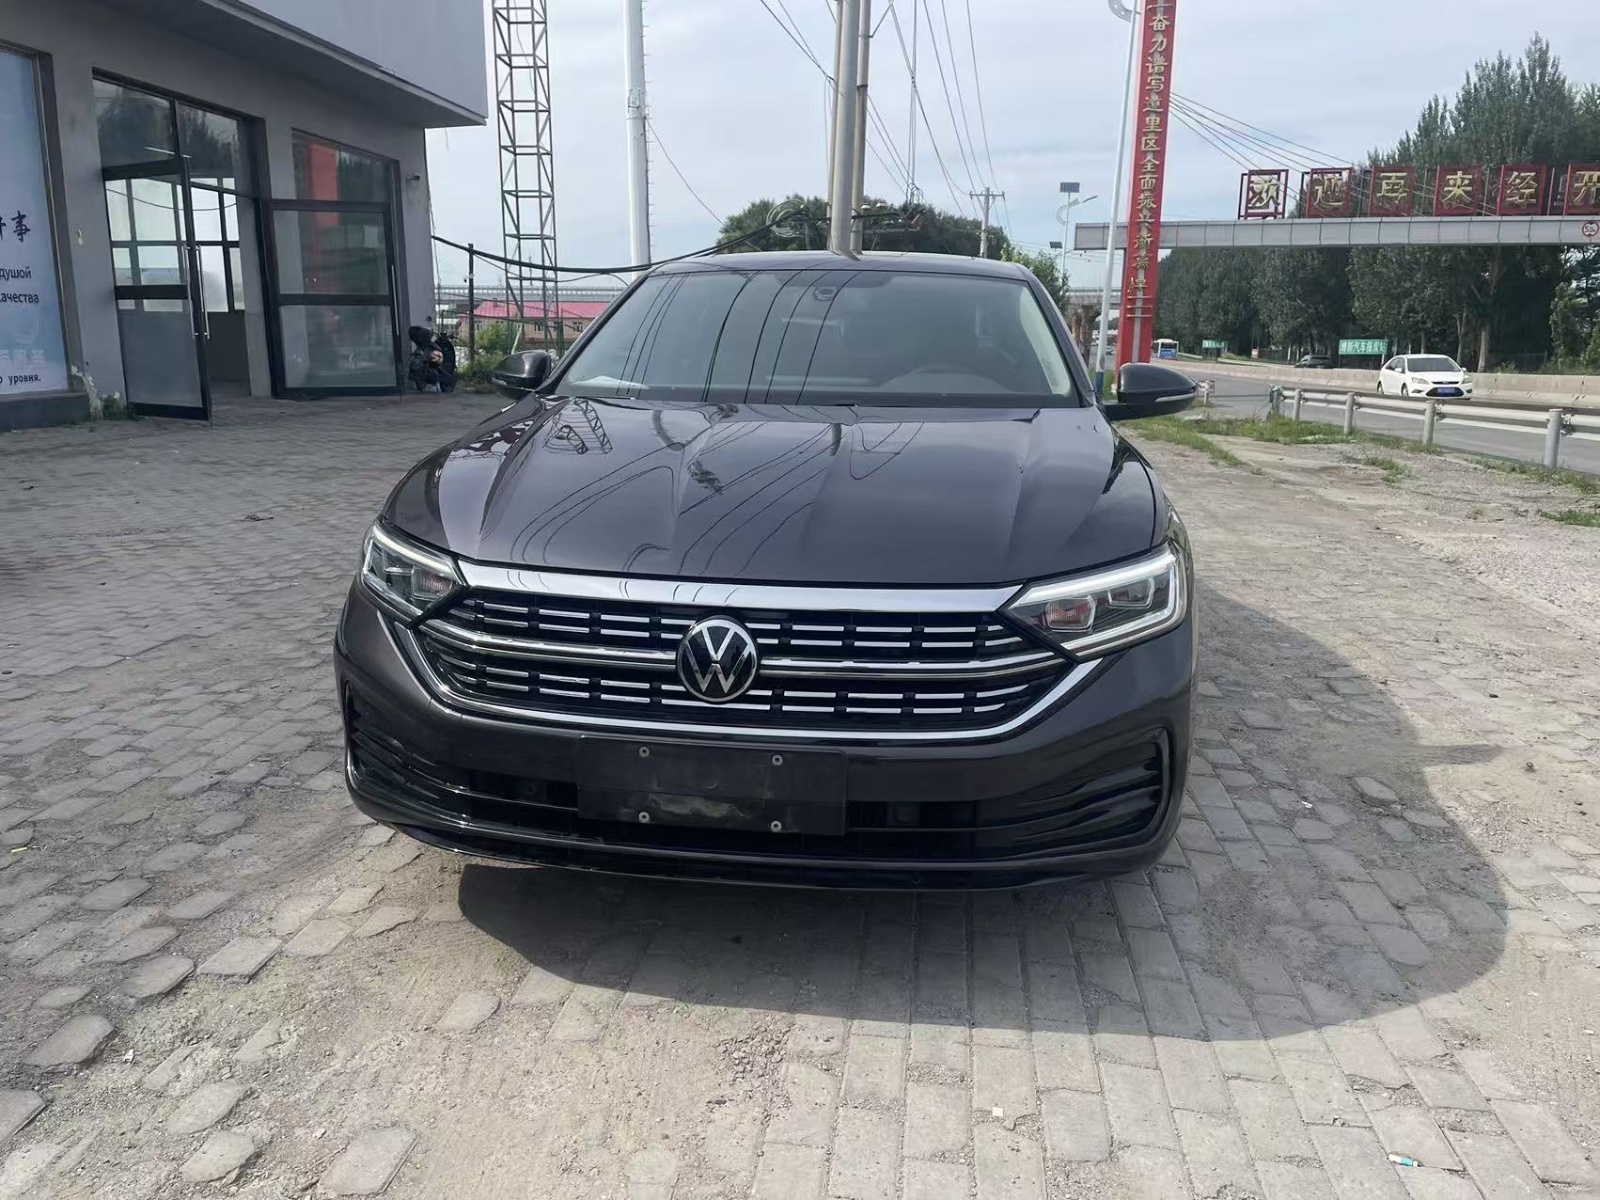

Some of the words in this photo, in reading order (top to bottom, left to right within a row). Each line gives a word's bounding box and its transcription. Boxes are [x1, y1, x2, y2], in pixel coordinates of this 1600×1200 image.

[0, 266, 32, 282] душой
[0, 292, 40, 304] ачества
[8, 374, 42, 386] уровня.
